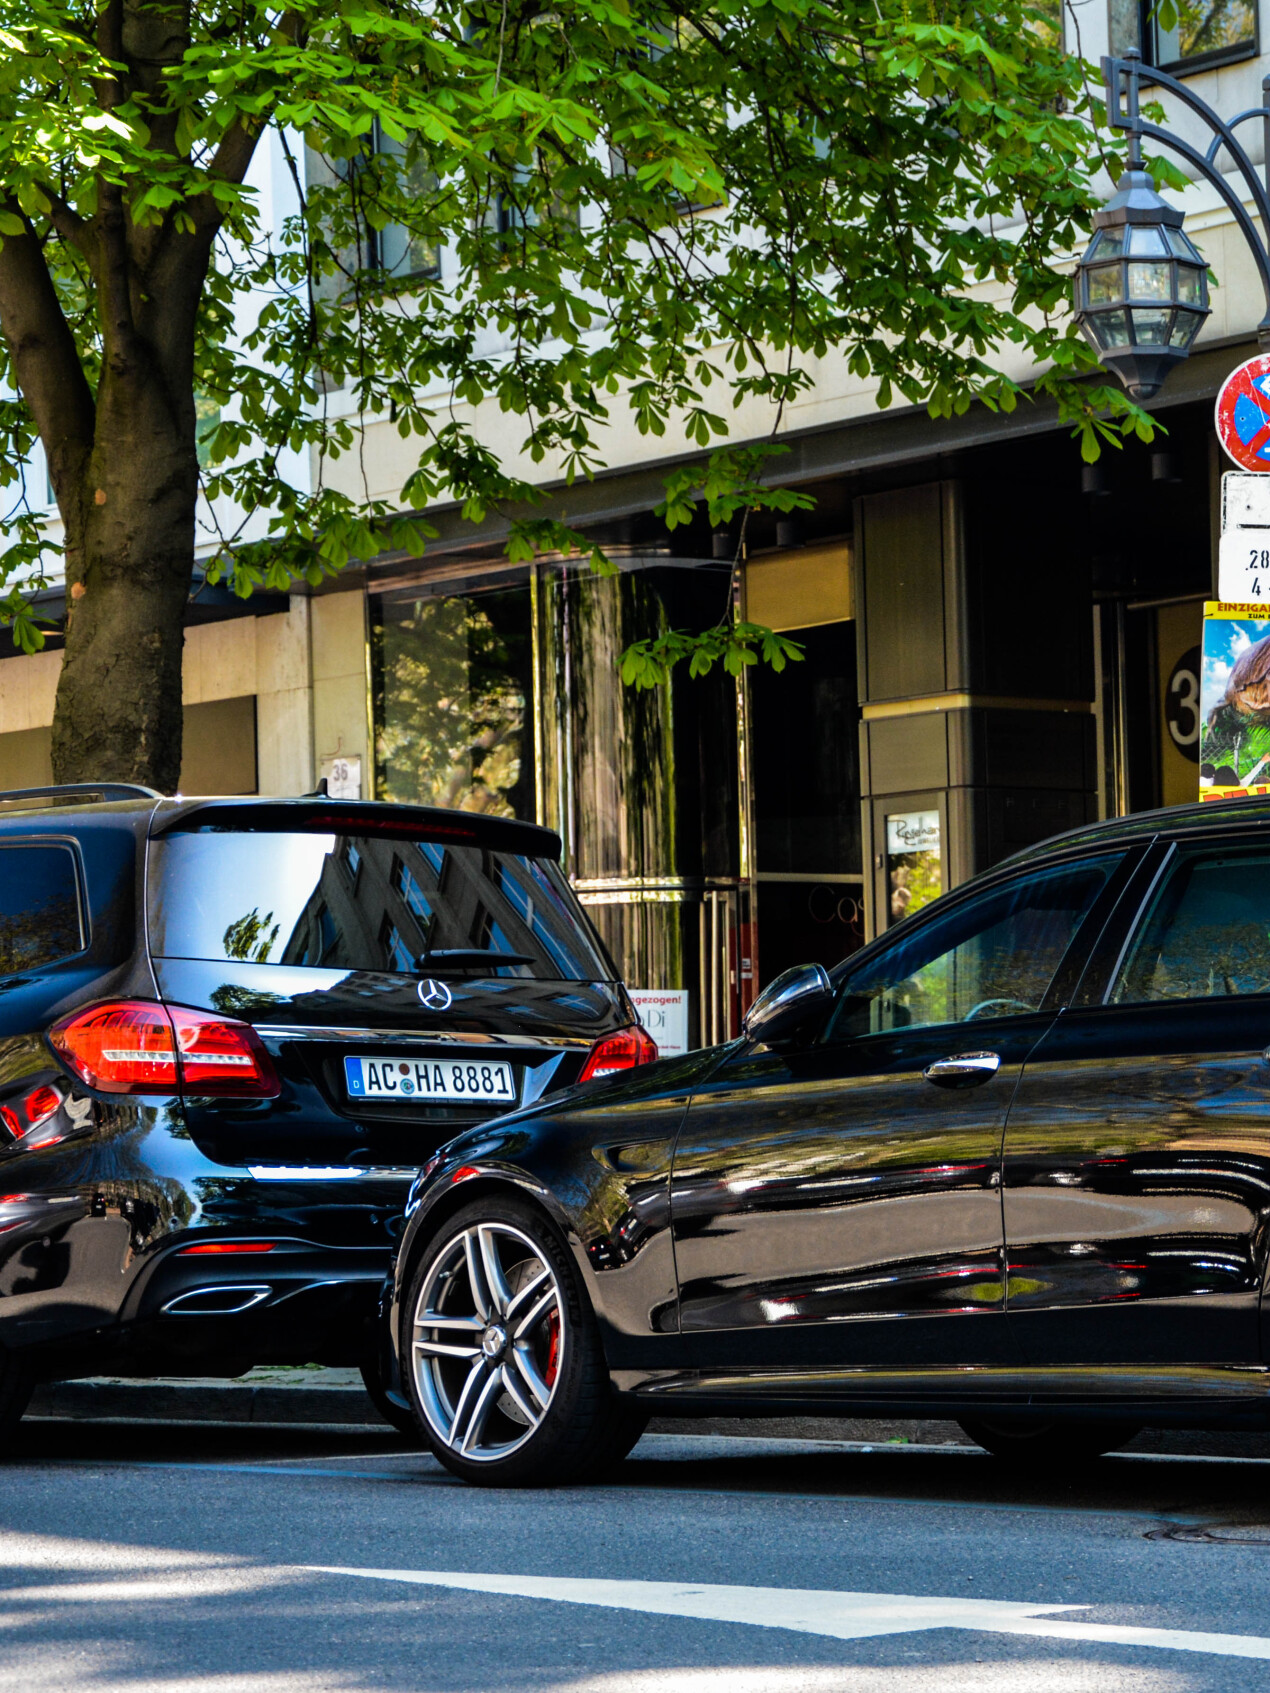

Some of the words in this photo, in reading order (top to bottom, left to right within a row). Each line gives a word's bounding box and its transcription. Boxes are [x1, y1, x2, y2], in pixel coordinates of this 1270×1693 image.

[1251, 577, 1262, 597] 4
[332, 763, 349, 782] 36
[367, 1062, 397, 1091] AC
[414, 1063, 447, 1092] HA
[451, 1065, 510, 1095] 8881
